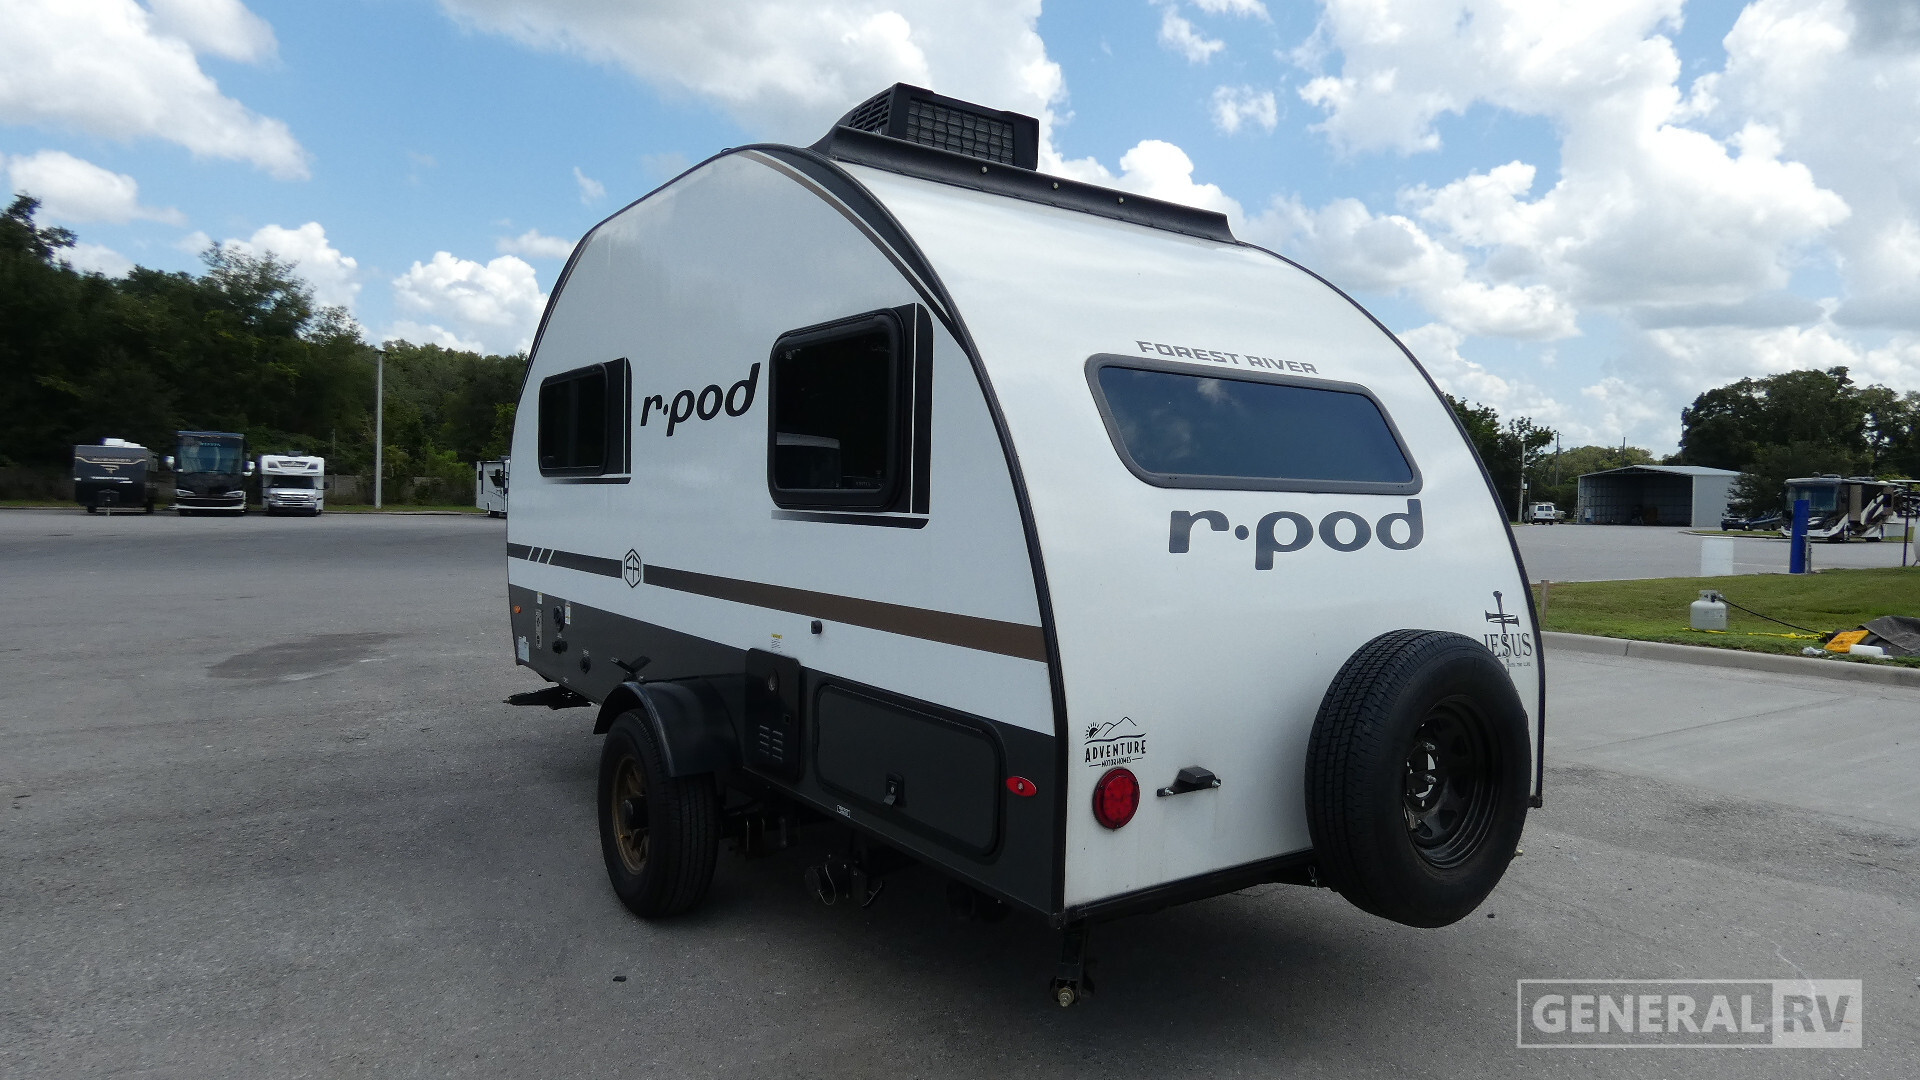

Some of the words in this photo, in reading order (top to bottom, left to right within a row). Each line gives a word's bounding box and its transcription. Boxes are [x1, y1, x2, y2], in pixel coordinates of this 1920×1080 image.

[1136, 341, 1239, 365] FOREST
[1244, 355, 1319, 374] RIVER
[1484, 633, 1532, 657] JESUS
[1085, 740, 1146, 762] ADVENTURE
[1101, 757, 1132, 767] MOTORHOMES
